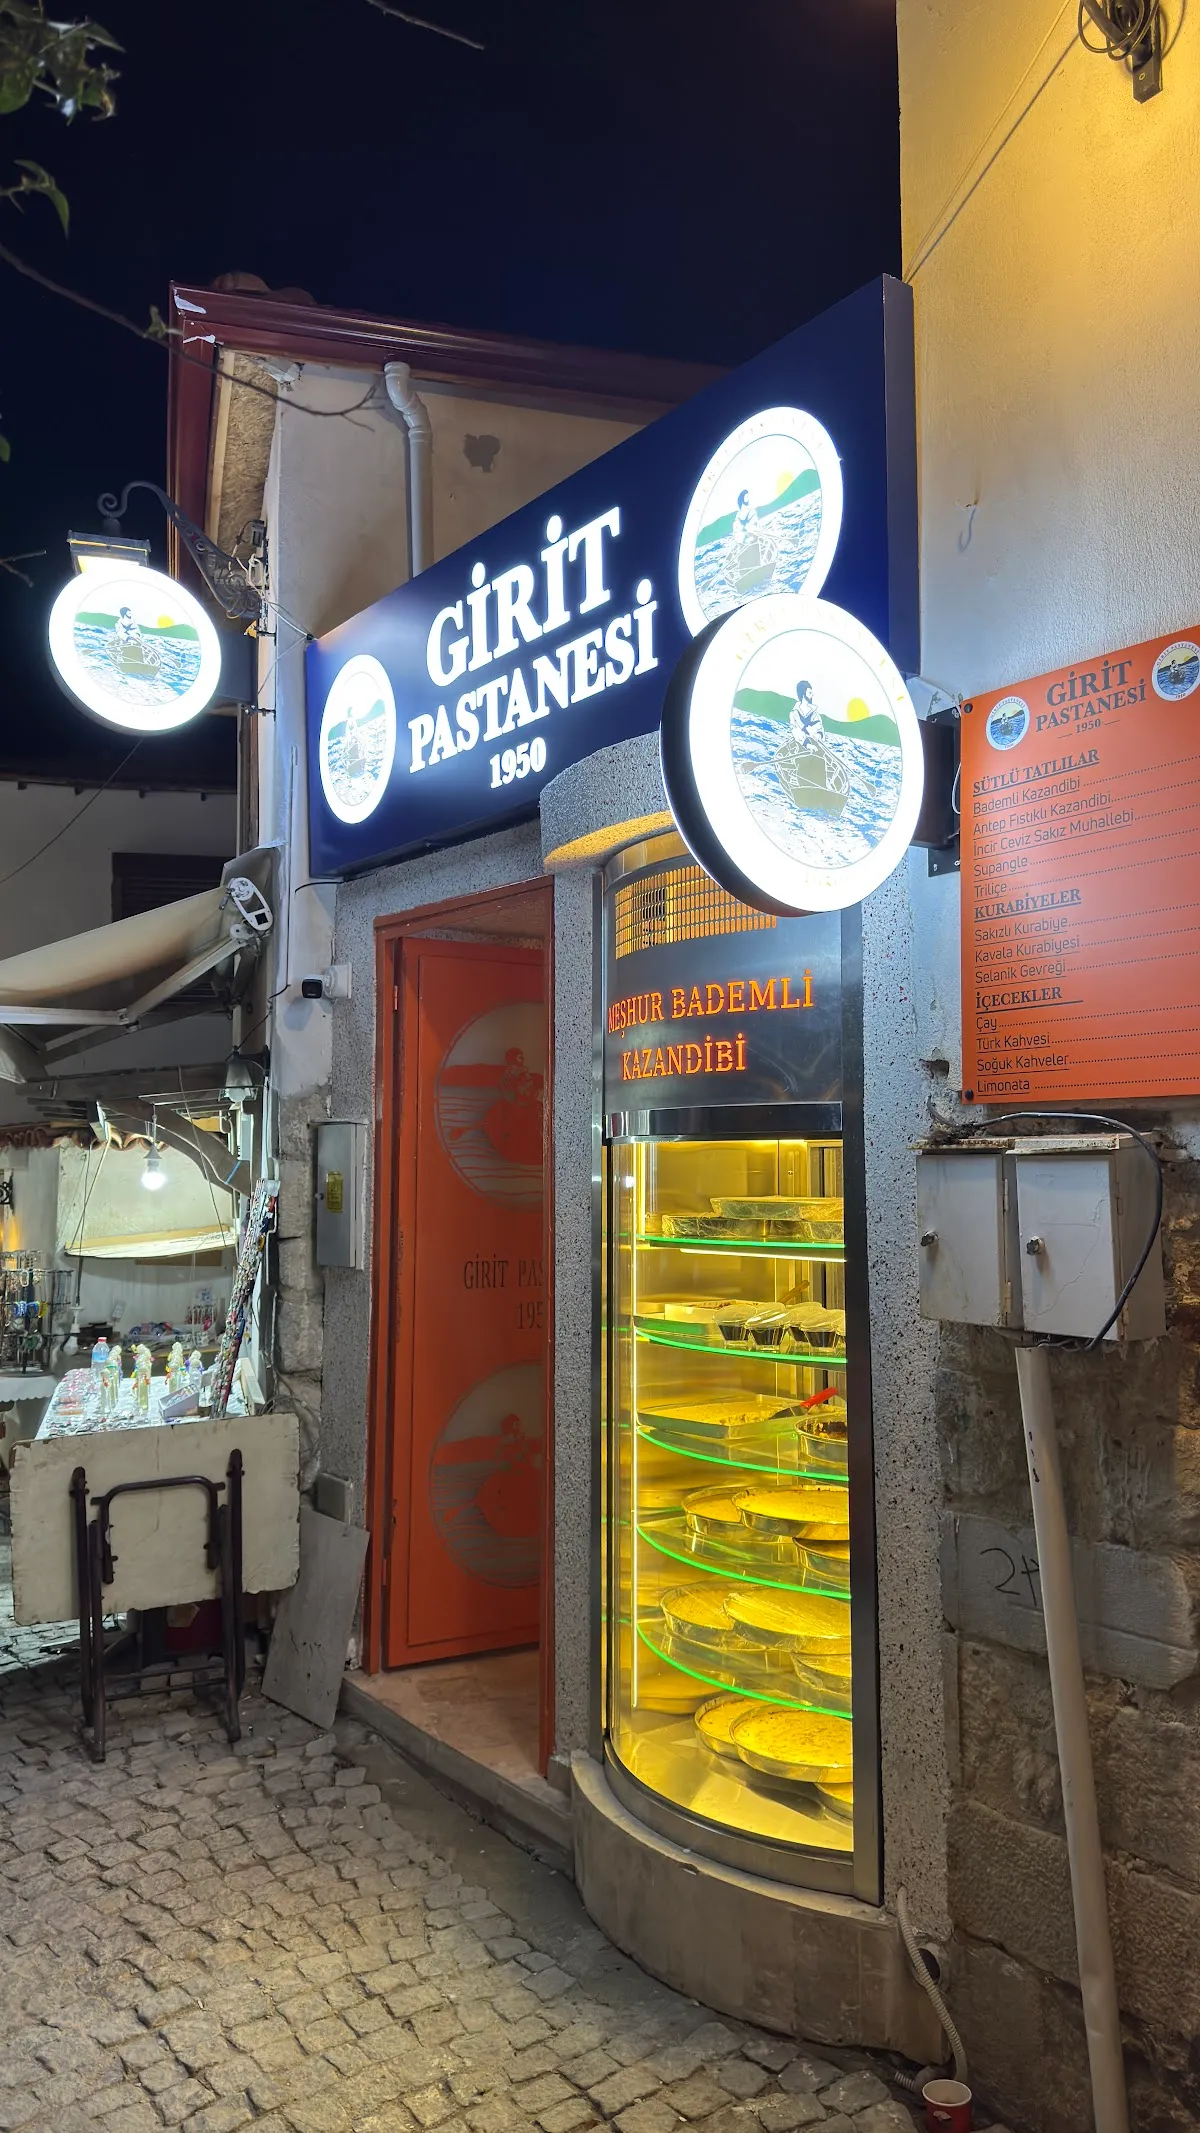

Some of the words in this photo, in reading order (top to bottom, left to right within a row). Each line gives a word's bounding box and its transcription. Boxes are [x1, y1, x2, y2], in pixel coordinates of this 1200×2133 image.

[425, 507, 621, 687] GİRİT
[407, 578, 659, 774] PASTANESİ
[1046, 659, 1132, 706] GİRİT
[1036, 678, 1147, 732] PASTANESİ
[1075, 719, 1101, 734] 1950
[490, 737, 547, 789] 1950
[973, 767, 1019, 794] SÜTLÜ
[1022, 749, 1100, 780] TATLILAR
[973, 791, 1019, 814] Bademli
[1022, 776, 1080, 801] Kazandibi
[973, 818, 1006, 835] Antep
[1009, 808, 1047, 827] Fıstıklı
[1050, 791, 1112, 816] Kazandibi
[973, 838, 998, 856] İncir
[1000, 832, 1031, 850] Ceviz
[1034, 823, 1066, 843] Sakız
[1069, 808, 1135, 834] Muhallebi
[973, 856, 1028, 877] Supangle
[974, 882, 1007, 898] Triliçe
[974, 888, 1082, 919] KURABİYELER
[974, 925, 1011, 942] Sakızlı
[1014, 917, 1068, 935] Kurabiye
[975, 947, 1013, 963] Kavala
[1016, 935, 1080, 957] Kurabiyesi
[975, 967, 1017, 984] Selanik
[1020, 959, 1066, 977] Gevreği
[608, 991, 664, 1038] MEŞHUR
[671, 968, 814, 1019] BADEMLİ
[976, 986, 1063, 1011] İÇECEKLER
[976, 1016, 997, 1032] Çay
[622, 1033, 747, 1080] KAZANDİBİ
[976, 1036, 1001, 1050] Türk
[1004, 1032, 1050, 1048] Kahvesi
[976, 1057, 1013, 1073] Soğuk
[1015, 1053, 1069, 1068] Kahveler
[977, 1079, 1030, 1093] Limonata
[463, 1254, 509, 1290] GİRİT
